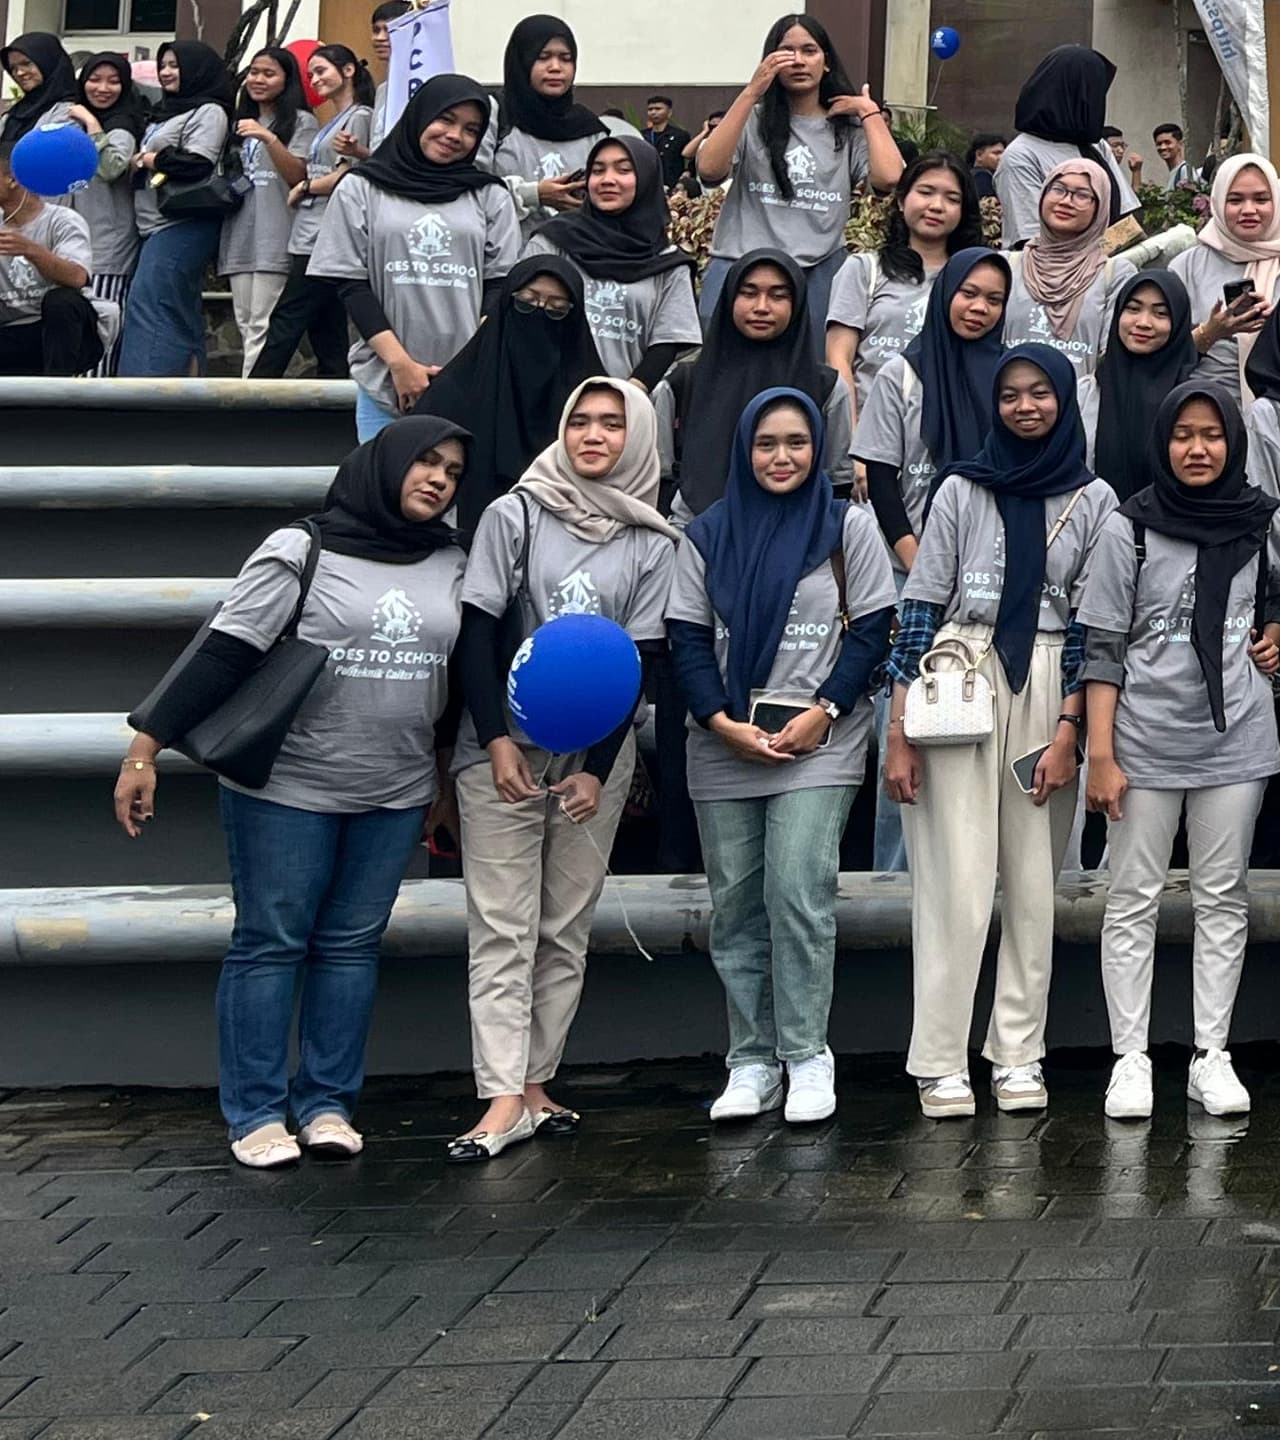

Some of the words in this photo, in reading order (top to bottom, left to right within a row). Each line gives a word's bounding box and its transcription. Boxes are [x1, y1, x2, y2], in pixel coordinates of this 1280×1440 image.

[796, 188, 843, 201] SCHOOL
[385, 260, 409, 272] OES
[412, 261, 428, 272] TO
[432, 263, 477, 278] SCHOO
[869, 336, 900, 348] GOES
[963, 572, 990, 585] OES
[784, 623, 829, 636] CHOO
[1149, 617, 1177, 631] GOS
[1181, 617, 1192, 628] T
[331, 647, 366, 662] OES
[369, 649, 390, 663] TO
